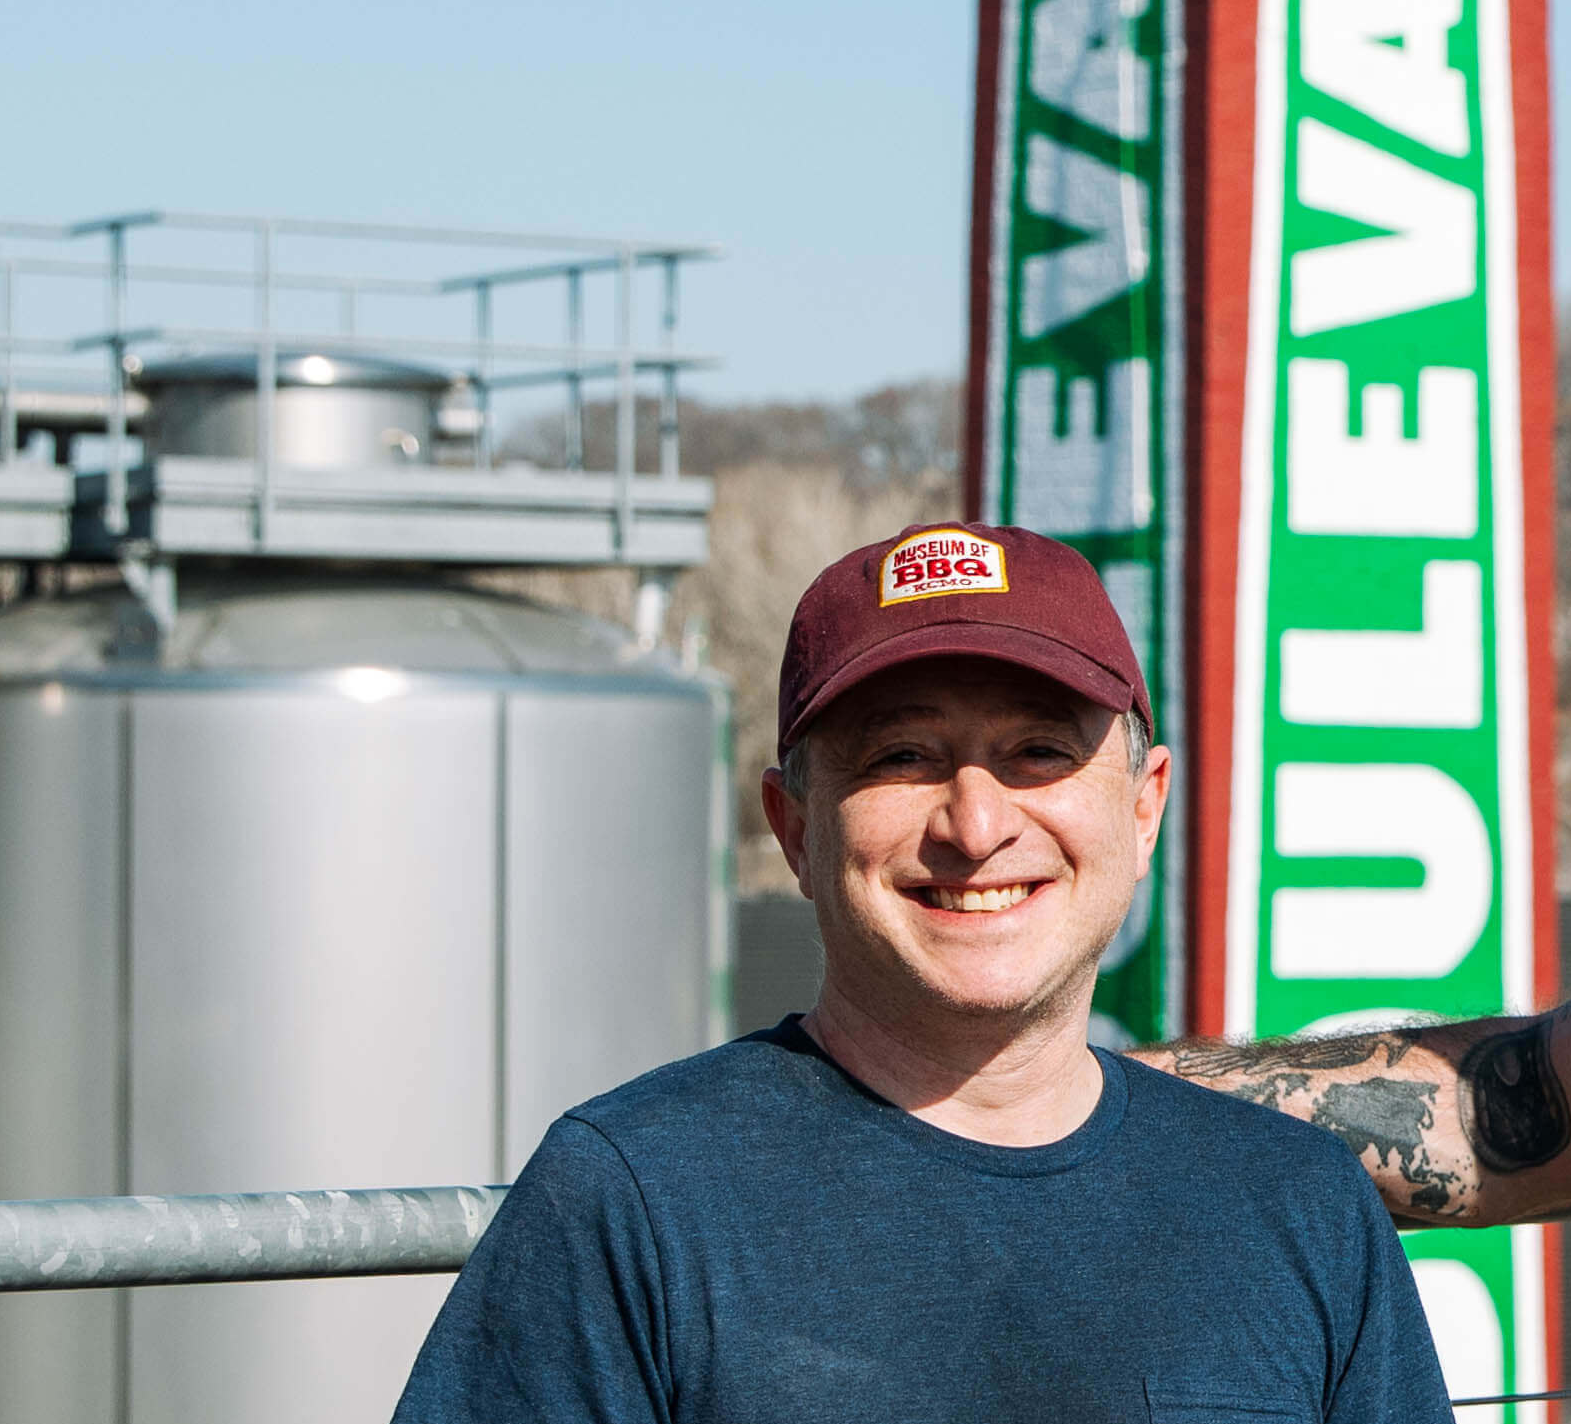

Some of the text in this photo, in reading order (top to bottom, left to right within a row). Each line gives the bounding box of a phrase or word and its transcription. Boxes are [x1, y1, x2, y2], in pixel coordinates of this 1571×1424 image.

[893, 539, 990, 568] MUSEUM OF
[892, 558, 992, 588] BBQ
[913, 578, 972, 592] KCMO
